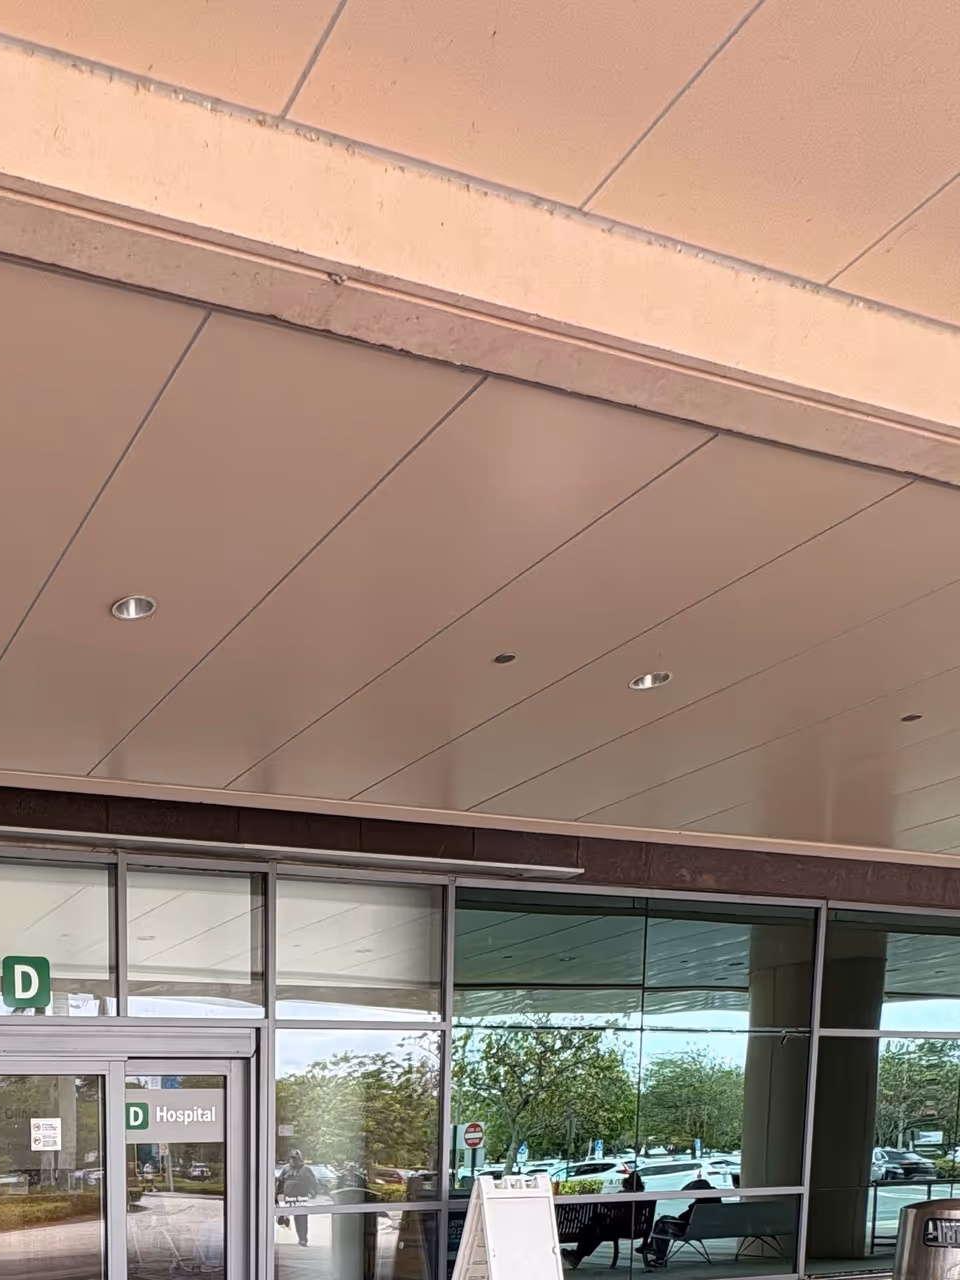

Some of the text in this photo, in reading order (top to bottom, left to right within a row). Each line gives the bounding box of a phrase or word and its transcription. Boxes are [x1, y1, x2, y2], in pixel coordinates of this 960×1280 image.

[14, 964, 39, 999] D
[129, 1106, 216, 1126] D Hospital
